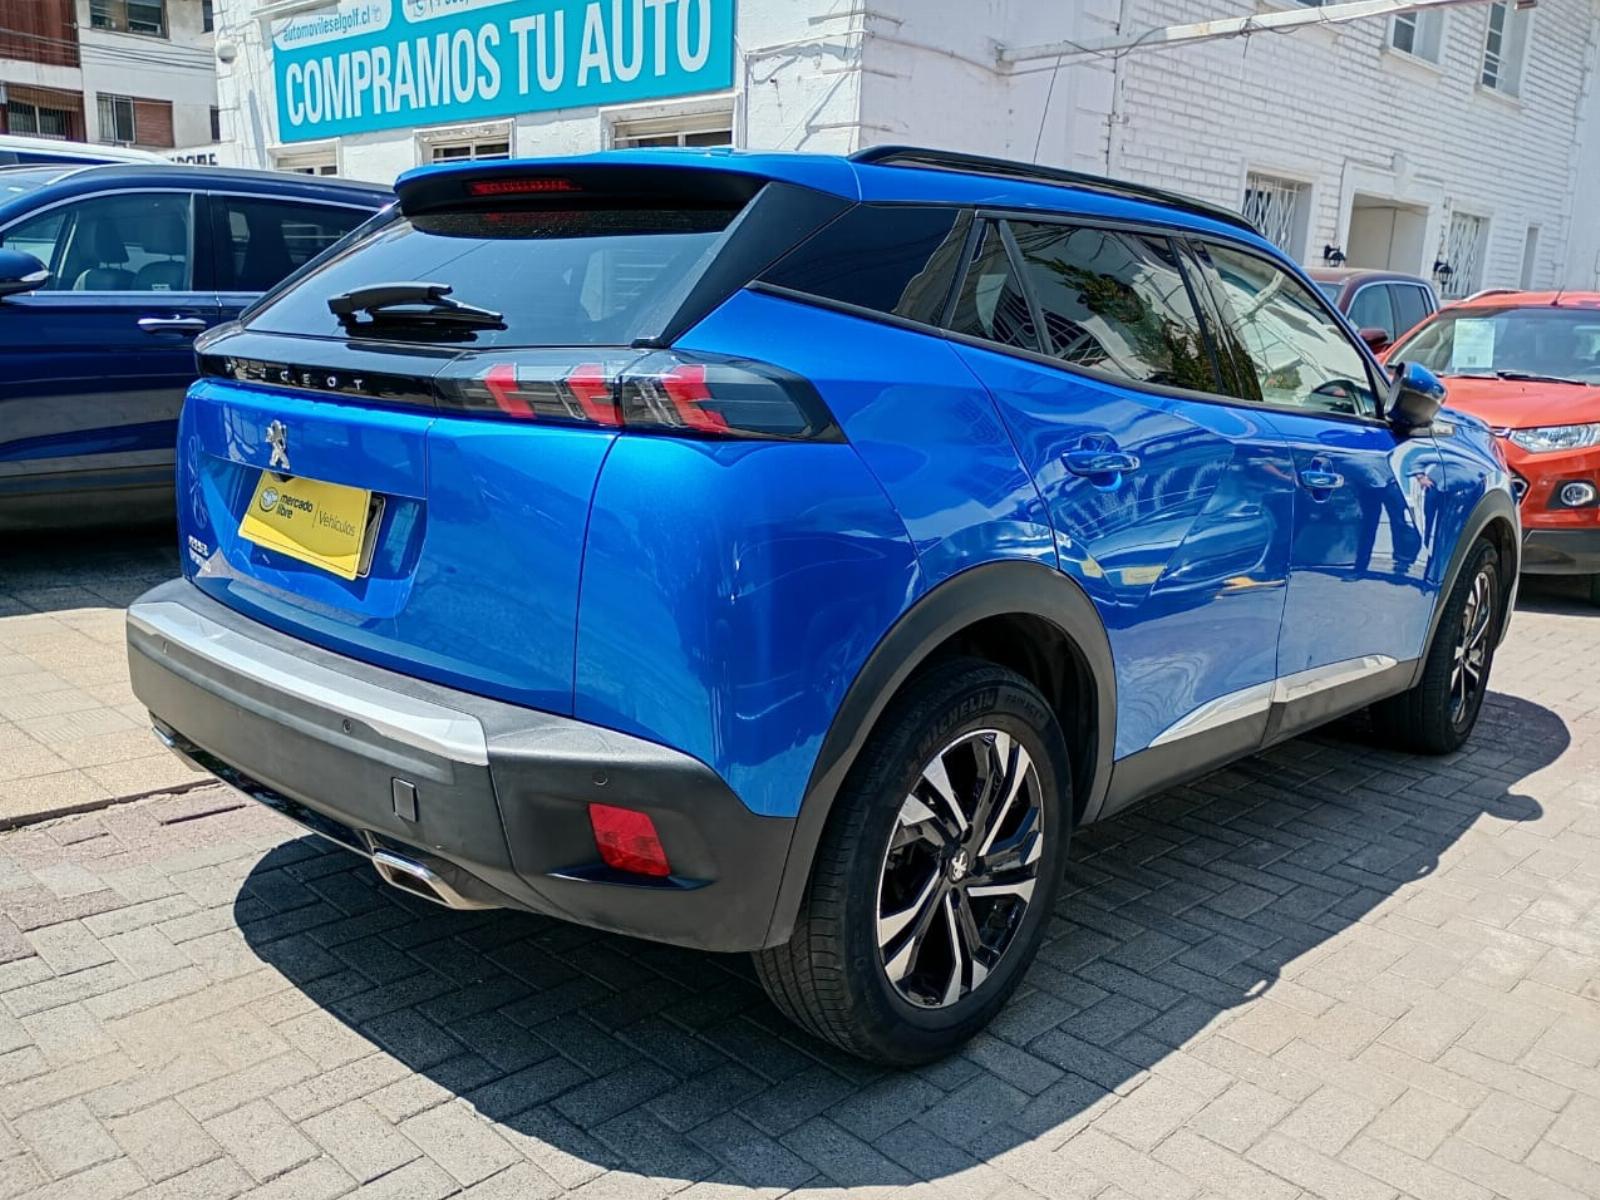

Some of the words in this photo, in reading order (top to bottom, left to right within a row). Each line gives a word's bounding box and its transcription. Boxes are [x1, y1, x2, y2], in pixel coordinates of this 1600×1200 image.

[283, 9, 370, 43] automovileselgolf.cl
[285, 23, 500, 126] COMPRAMOS
[510, 10, 565, 95] TU
[577, 0, 711, 87] AUTO
[276, 503, 293, 519] libre
[280, 494, 313, 513] mercado
